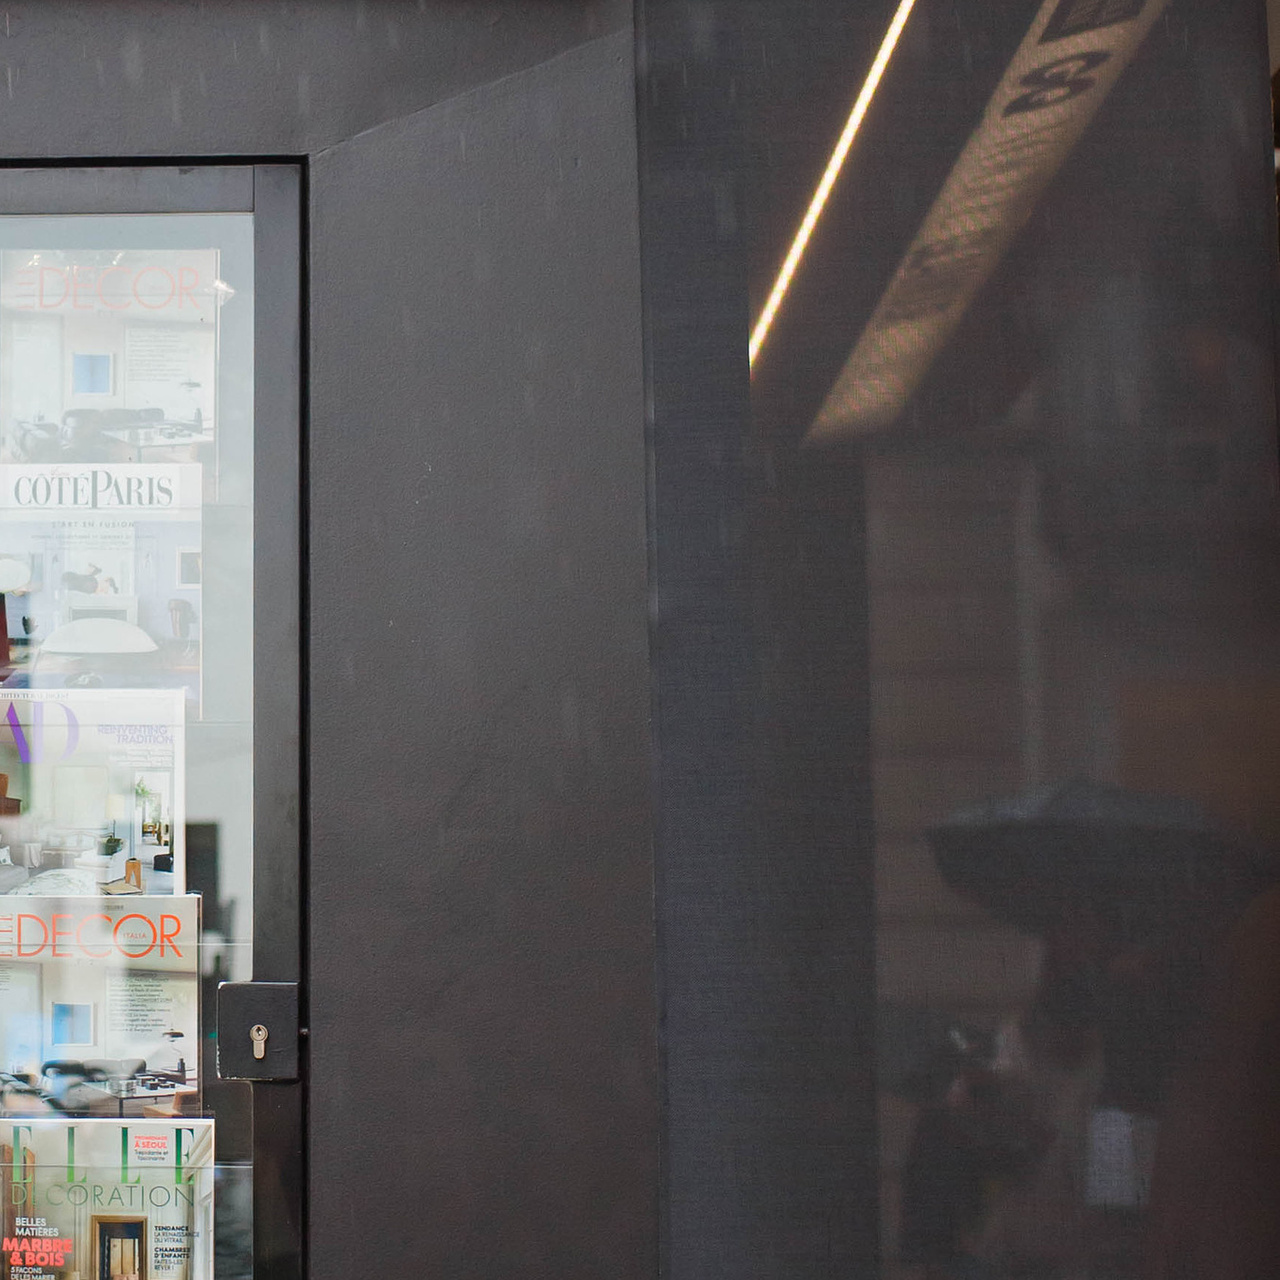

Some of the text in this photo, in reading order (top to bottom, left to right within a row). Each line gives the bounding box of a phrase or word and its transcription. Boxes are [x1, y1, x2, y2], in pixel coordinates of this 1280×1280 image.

[38, 266, 201, 310] DECOR
[97, 724, 167, 735] REINVENTING
[116, 734, 174, 745] TRADITION
[16, 913, 183, 958] DECOR
[10, 1125, 195, 1185] ELLE
[15, 1217, 46, 1226] BELLES
[2, 1237, 73, 1253] MARBRE
[9, 1252, 65, 1266] & BOIS
